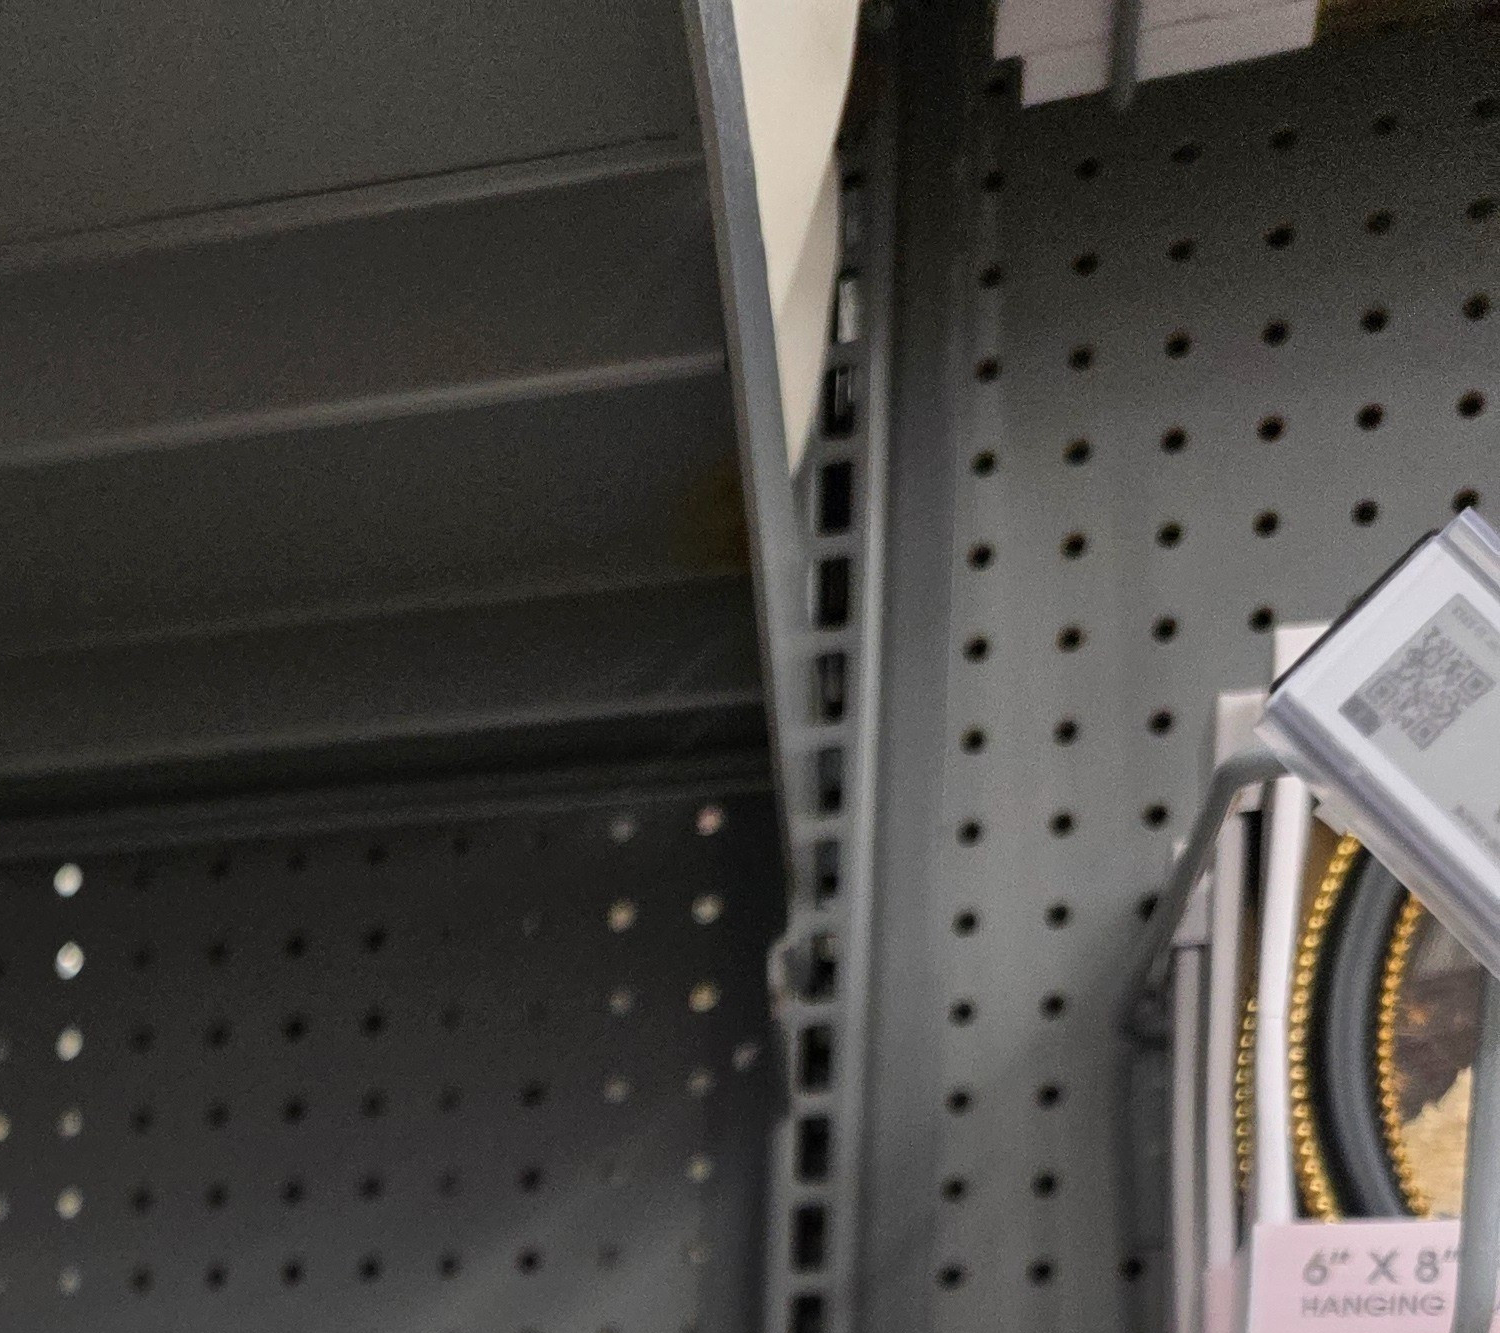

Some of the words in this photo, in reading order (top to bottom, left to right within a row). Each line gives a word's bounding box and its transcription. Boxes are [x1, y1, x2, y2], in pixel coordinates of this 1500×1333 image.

[1302, 1249, 1350, 1286] 6"
[1367, 1250, 1399, 1285] X
[1301, 1295, 1445, 1318] HANGING
